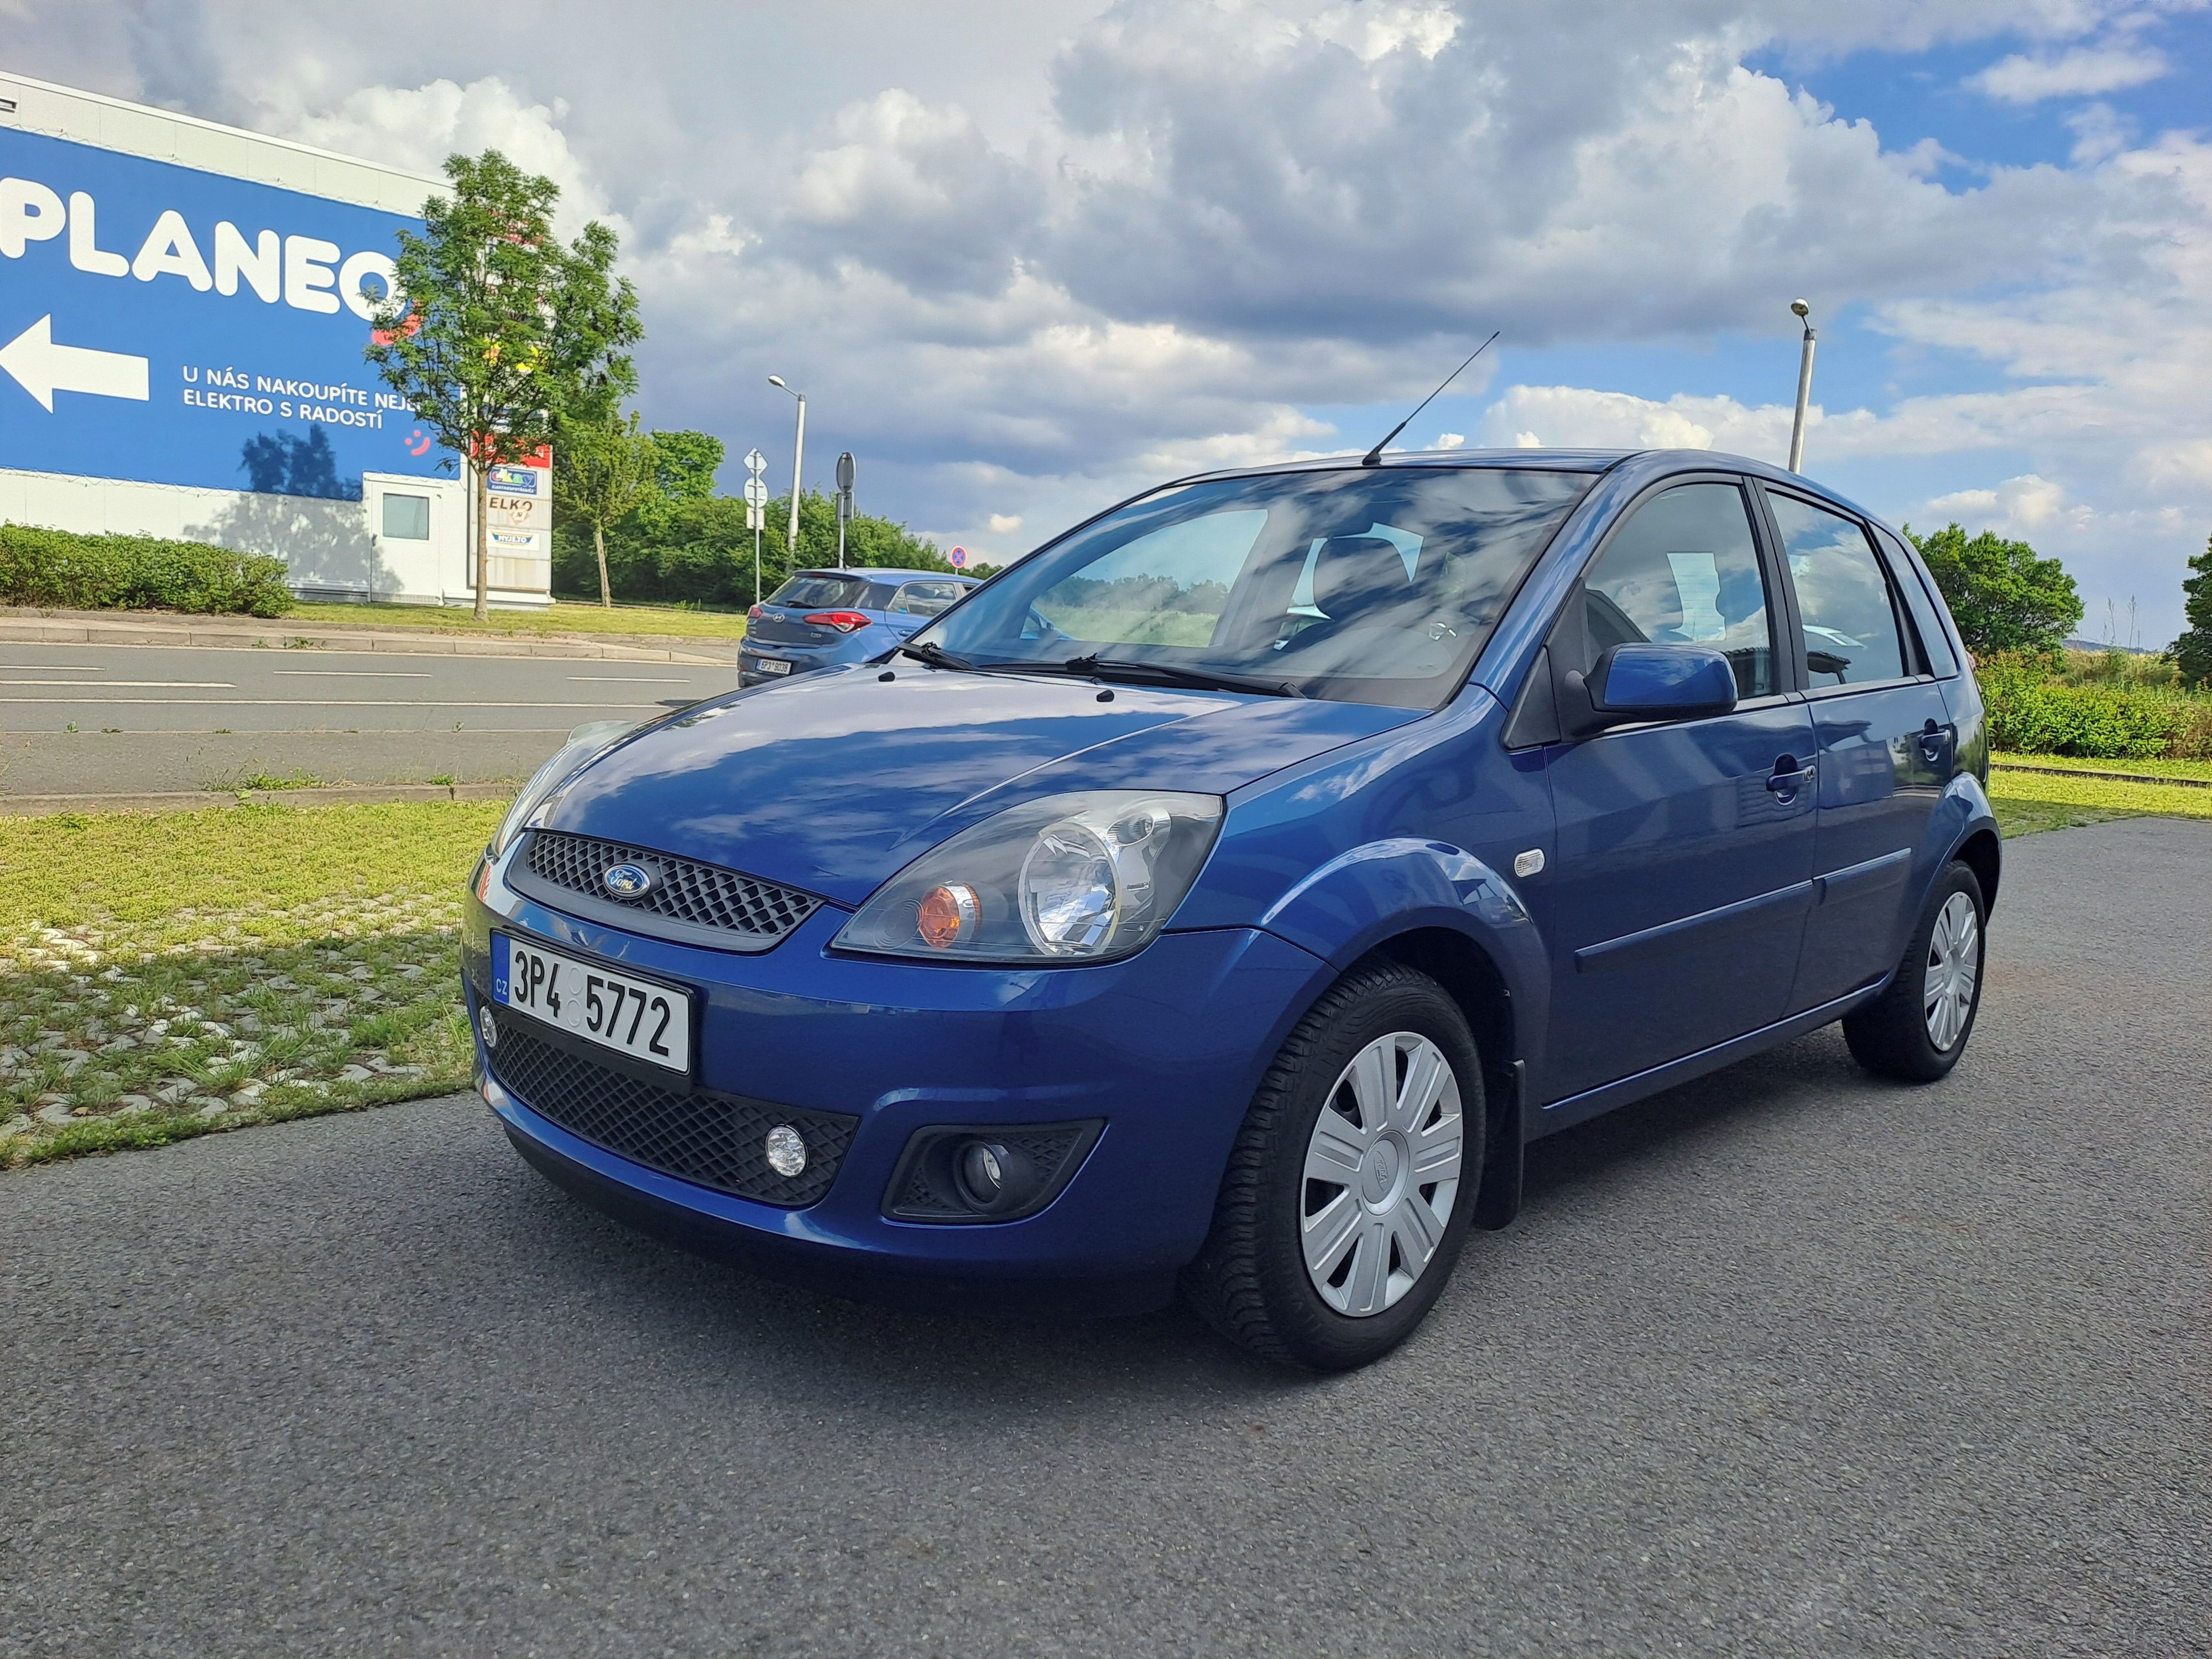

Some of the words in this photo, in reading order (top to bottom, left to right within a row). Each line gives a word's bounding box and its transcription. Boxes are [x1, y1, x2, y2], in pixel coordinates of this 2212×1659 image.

[0, 177, 406, 322] PLANEO
[182, 366, 197, 382] U
[206, 367, 249, 389] NÁS
[257, 375, 367, 406] NAKOUPÍTE
[183, 389, 273, 415] ELEKTRO
[280, 401, 293, 418] S
[299, 404, 382, 429] RADOSTÍ
[489, 497, 533, 512] ELKO
[610, 869, 638, 890] Ford
[495, 978, 508, 995] CZ
[514, 950, 561, 1019] 3P4
[586, 974, 670, 1057] 5772
